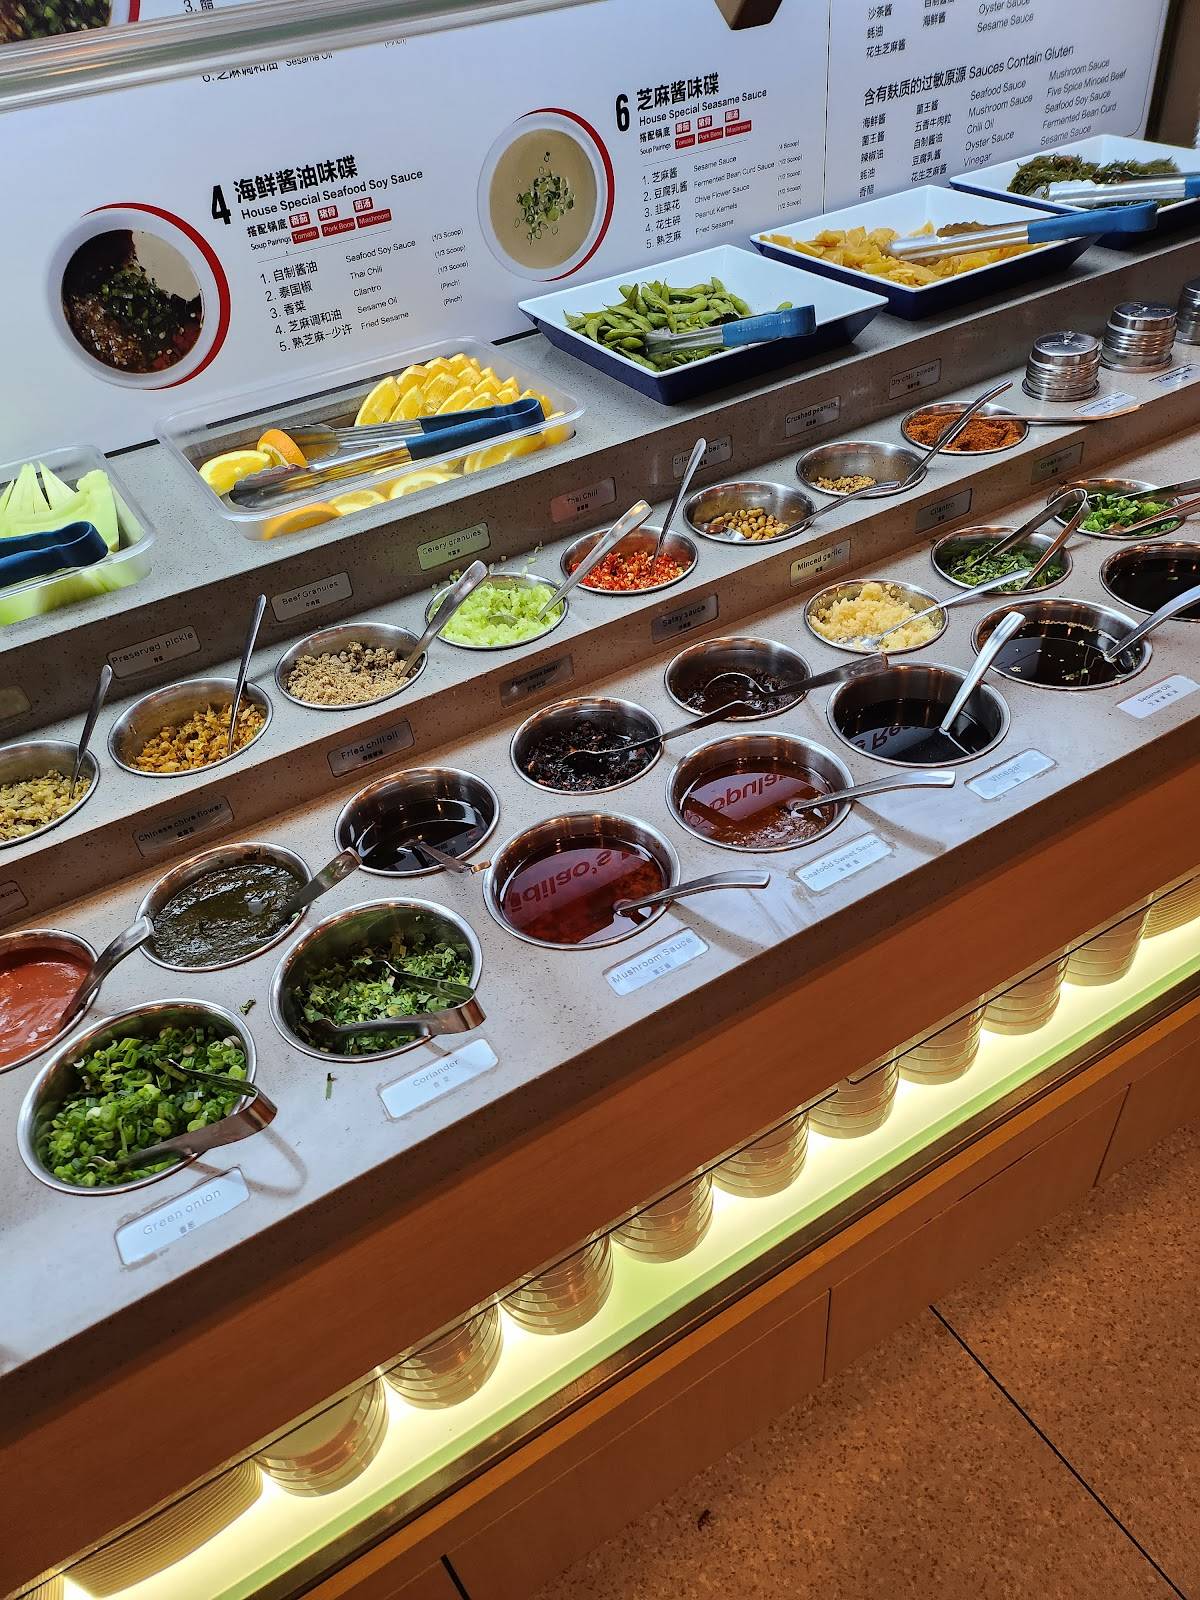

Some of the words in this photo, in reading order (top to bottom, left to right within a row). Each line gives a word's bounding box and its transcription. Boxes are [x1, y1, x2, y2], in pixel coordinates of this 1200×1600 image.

[977, 20, 1008, 33] Sesame
[1010, 12, 1034, 24] Sauce
[866, 38, 906, 58] 花生芝麻酱
[969, 61, 1004, 80] Sauces
[1007, 51, 1043, 70] Contain
[1045, 45, 1074, 61] Gluten
[1048, 64, 1087, 81] Mushroom
[1088, 58, 1110, 72] Sauce
[970, 85, 1001, 101] Seafood
[1002, 78, 1027, 92] Sauce
[1046, 87, 1062, 98] Five
[1063, 81, 1083, 94] Spice
[1084, 74, 1109, 88] Minced
[1110, 68, 1127, 81] Beef
[615, 93, 630, 131] 6
[637, 72, 720, 111] 芝麻酱味碟
[639, 114, 667, 126] House
[669, 103, 700, 120] Special
[702, 95, 740, 111] Seasame
[742, 89, 767, 101] Sauce
[968, 101, 1008, 117] Mushroom
[1010, 94, 1033, 107] Sauce
[1044, 99, 1074, 114] Seafood
[1075, 96, 1088, 106] Soy
[1089, 89, 1112, 102] Sauce
[967, 120, 983, 135] Chili
[984, 118, 995, 129] Oil
[1042, 112, 1080, 129] Fermented
[1081, 107, 1099, 119] Bean
[965, 137, 990, 152] Oyster
[991, 130, 1015, 144] Sauce
[1040, 132, 1069, 146] Sesame
[1070, 124, 1092, 138] Sauce
[719, 155, 737, 166] Sauce
[963, 152, 992, 168] Vinegar
[642, 175, 650, 185] 1.
[652, 167, 678, 183] 芝麻酱
[211, 185, 231, 225] 4
[233, 154, 358, 203] 海鲜酱油味碟
[241, 204, 278, 220] House
[279, 191, 321, 211] Special
[323, 181, 367, 201] Seafood
[369, 178, 388, 189] Soy
[390, 170, 423, 185] Sauce
[643, 191, 652, 202] 2.
[644, 207, 653, 218] 3.
[250, 242, 267, 251] Soup
[293, 231, 317, 240] Tomato
[323, 225, 338, 234] Pork
[338, 221, 355, 230] Bone
[359, 212, 390, 224] Mushroom
[645, 223, 654, 232] 4.
[345, 249, 376, 263] Seafood
[377, 245, 392, 255] Soy
[393, 240, 416, 251] Sauce
[646, 238, 654, 249] 5.
[260, 273, 271, 284] 1.
[273, 260, 318, 282] 自制酱油
[350, 270, 366, 279] Thai
[367, 265, 383, 276] Chili
[265, 290, 277, 302] 2.
[279, 280, 313, 299] 泰国椒
[353, 284, 382, 297] Cilantro
[269, 307, 281, 319] 3.
[283, 300, 307, 316] 香菜
[357, 301, 387, 314] Sesame
[387, 296, 398, 305] Oil
[275, 324, 286, 335] 4.
[288, 308, 343, 333] 芝麻调和油
[360, 319, 379, 330] Fried
[380, 311, 409, 325] Sesame
[279, 341, 291, 352] 5.
[797, 555, 822, 571] Minced
[822, 548, 843, 562] garlic
[111, 643, 161, 665] Preserved
[164, 631, 194, 649] pickle
[340, 745, 365, 760] Fried
[386, 731, 399, 741] oil
[611, 953, 662, 984] Mushroom
[662, 937, 694, 956] Sauce
[412, 1058, 459, 1087] Coriander
[143, 1210, 183, 1236] Green
[185, 1188, 222, 1213] onion
